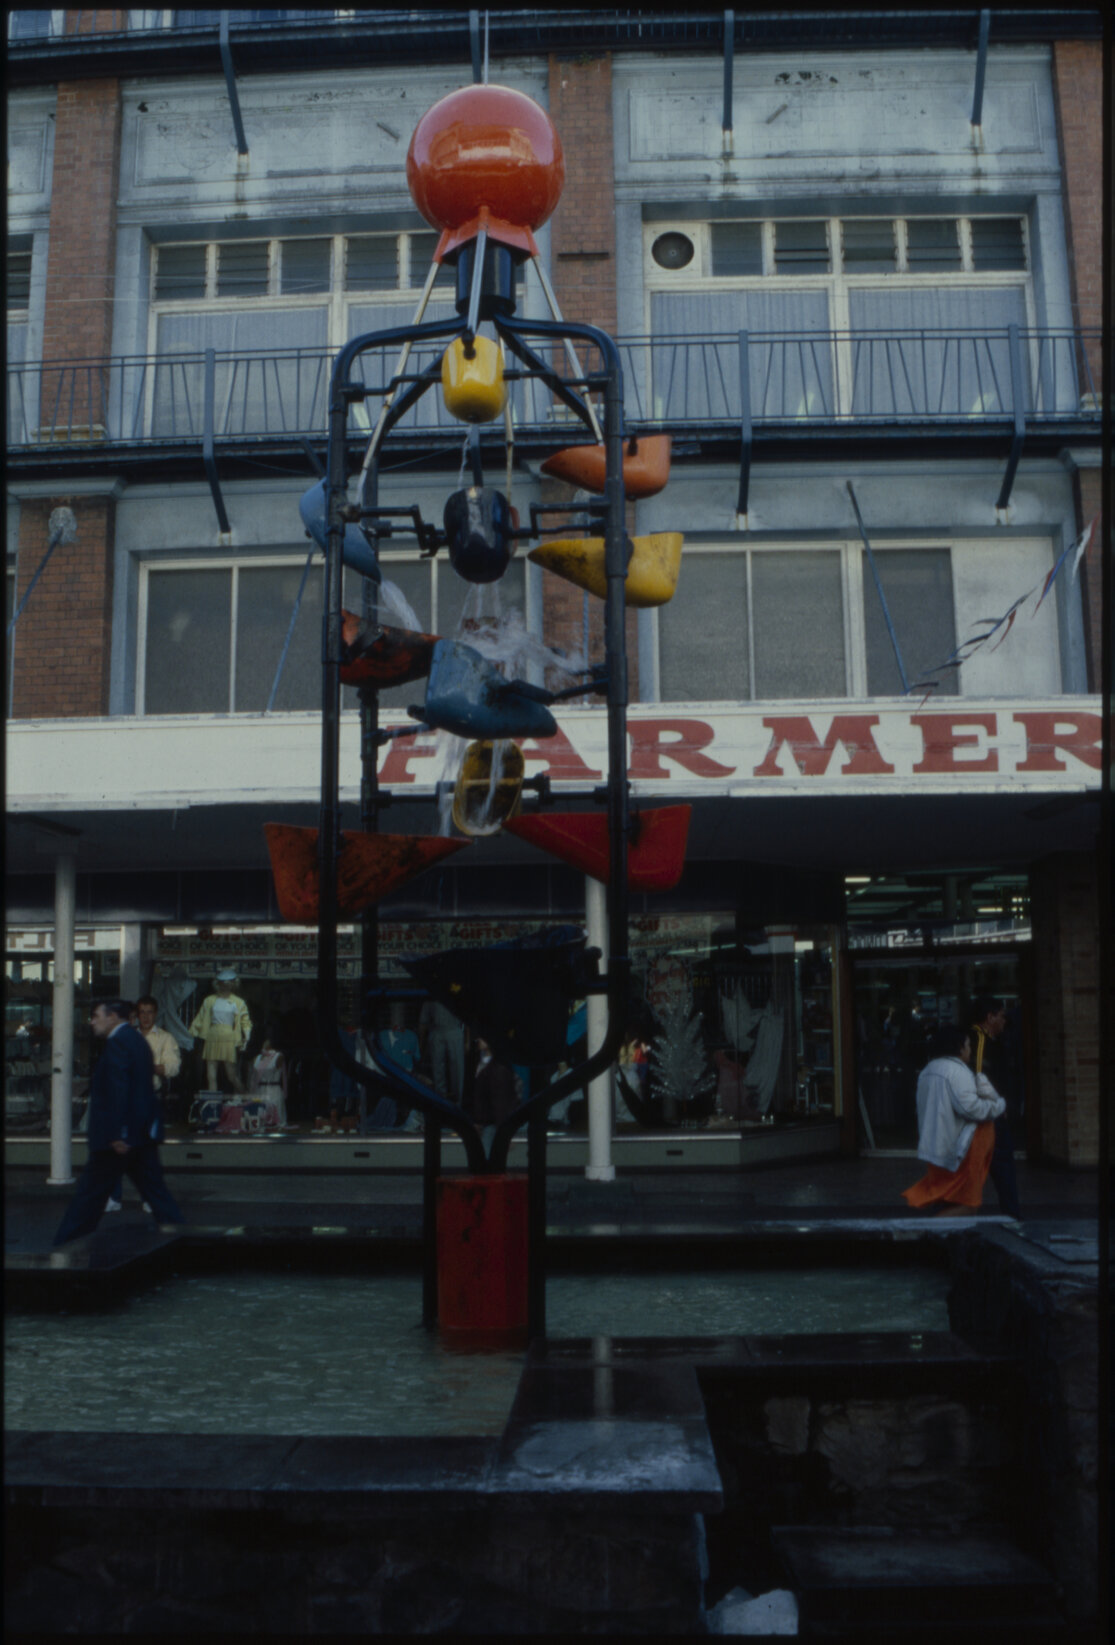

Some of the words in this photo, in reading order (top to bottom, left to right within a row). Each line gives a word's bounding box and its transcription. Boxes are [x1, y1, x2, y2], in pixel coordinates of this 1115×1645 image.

[377, 711, 1103, 784] FARMER
[460, 927, 502, 940] GIFTS
[205, 942, 231, 951] YOUR
[233, 942, 269, 951] CHOICE
